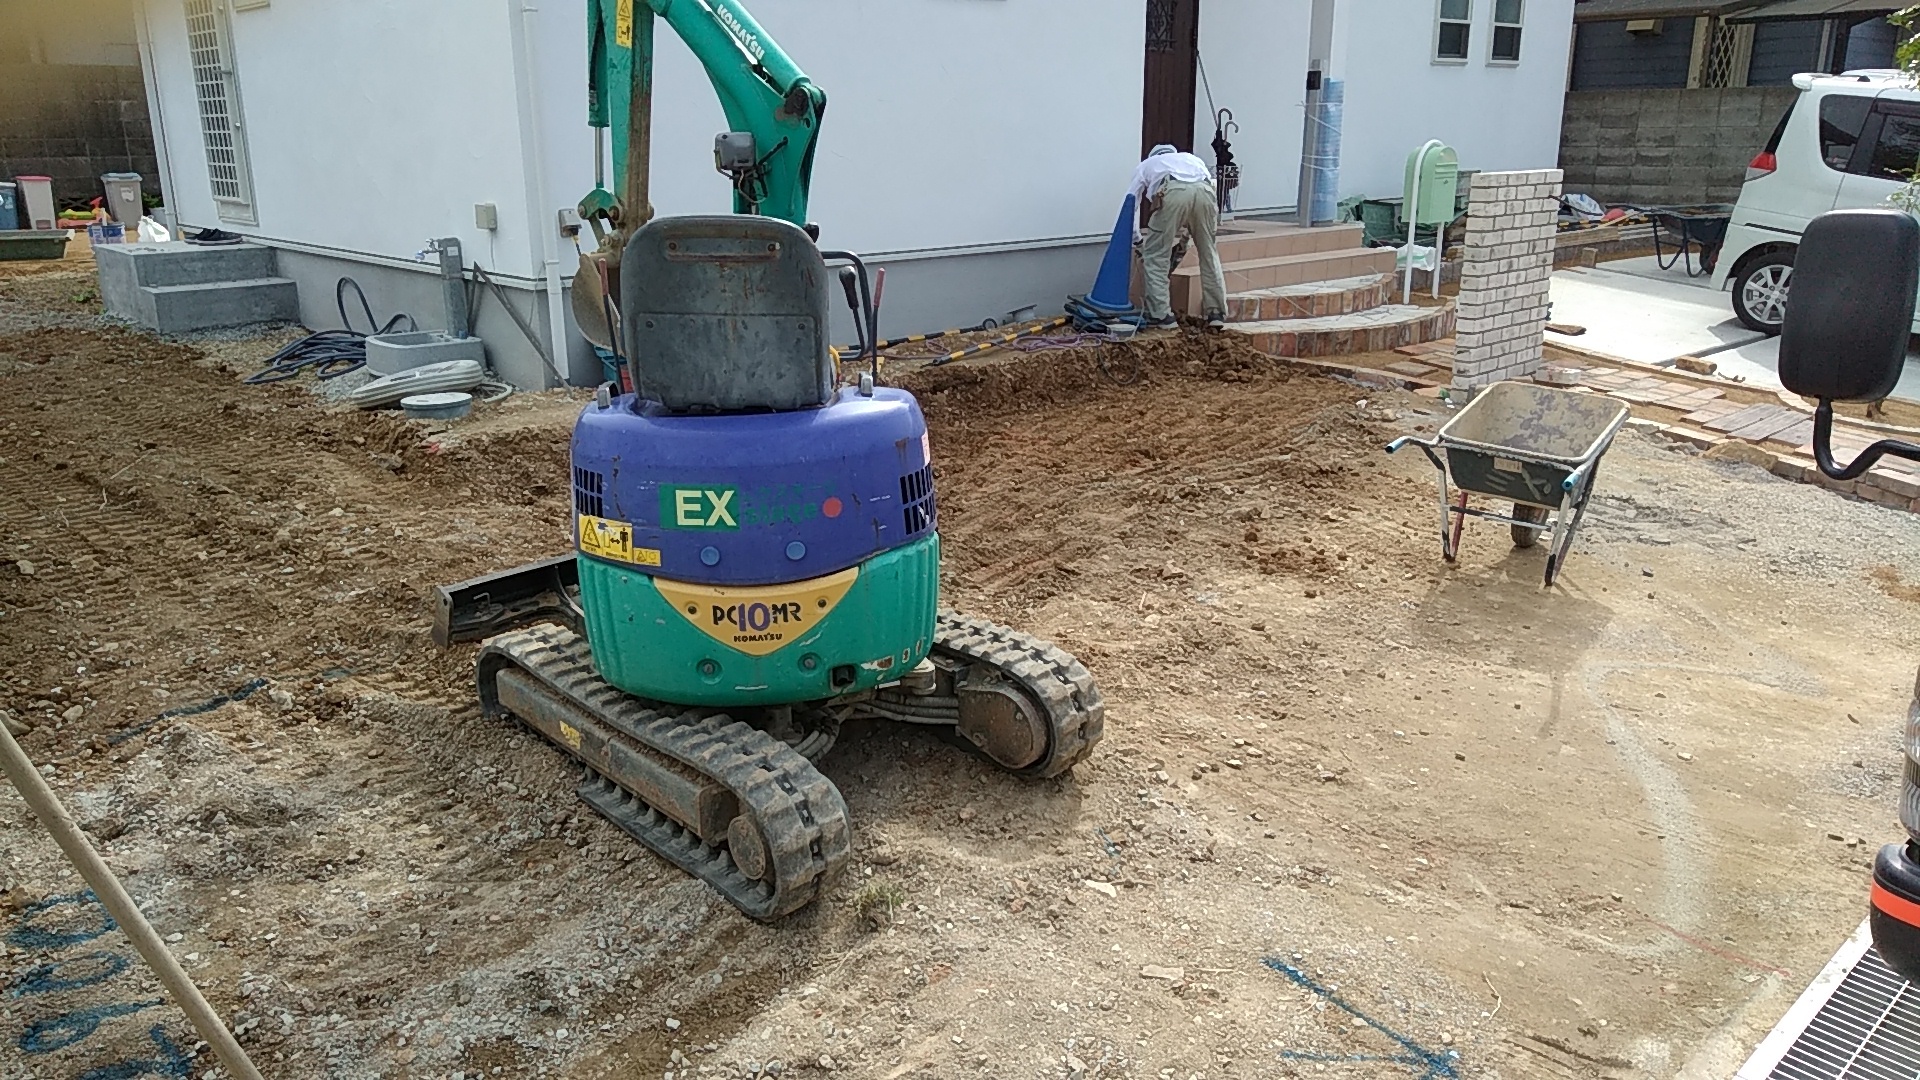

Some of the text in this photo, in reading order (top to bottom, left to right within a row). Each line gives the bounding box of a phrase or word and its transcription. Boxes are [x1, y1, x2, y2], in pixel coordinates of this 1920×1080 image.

[717, 4, 765, 60] KOMATSU
[675, 489, 737, 526] EX
[712, 602, 802, 632] PC10MR
[733, 632, 783, 642] KOMATSU
